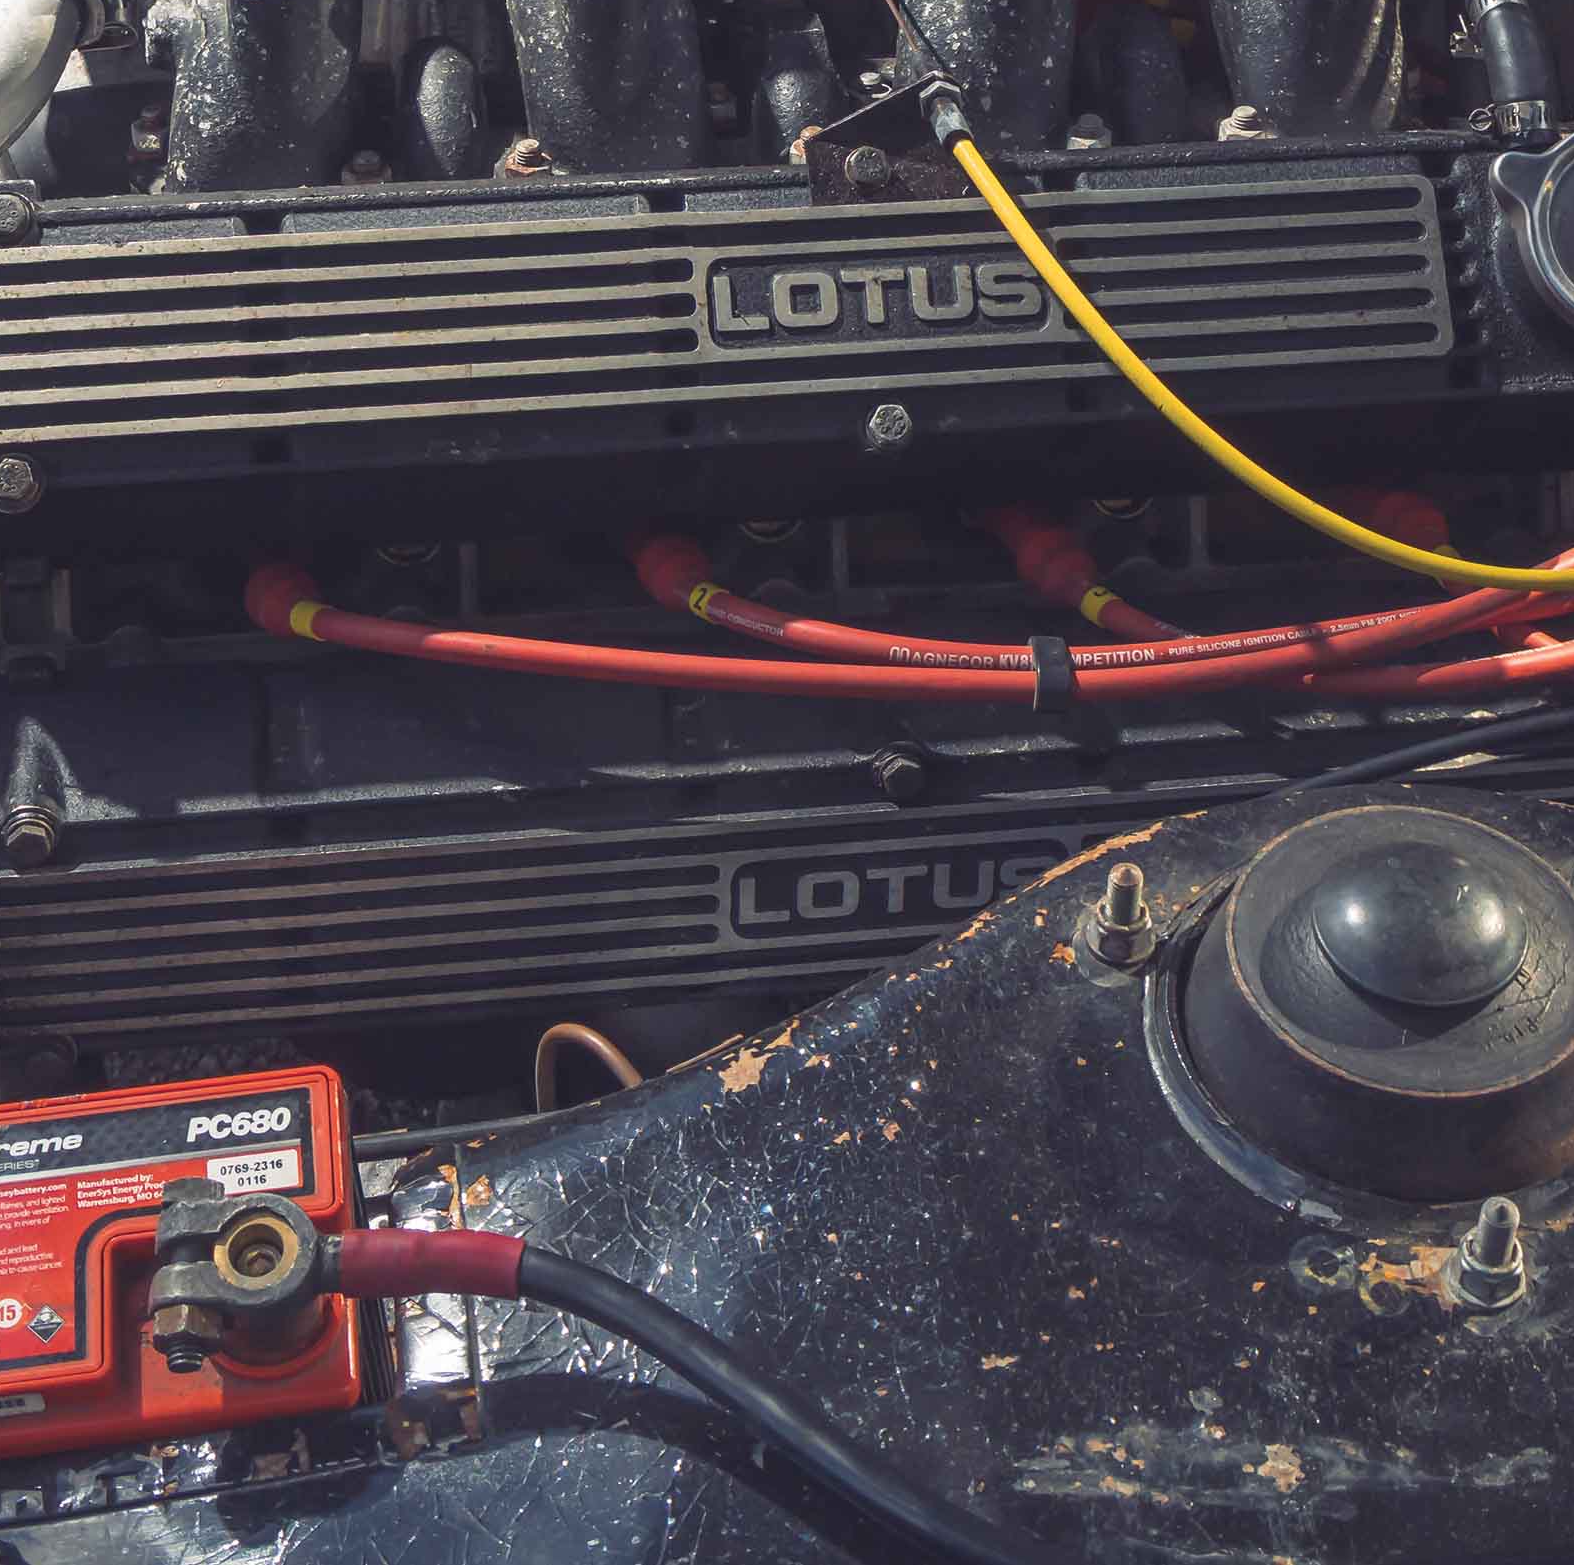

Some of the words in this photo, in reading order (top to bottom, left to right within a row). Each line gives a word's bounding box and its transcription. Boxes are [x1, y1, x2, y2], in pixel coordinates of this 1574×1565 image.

[713, 261, 1044, 332] LOTUS
[693, 587, 708, 611] 2
[1071, 648, 1155, 666] MPETITION
[1168, 646, 1195, 656] PURE
[1196, 641, 1242, 653] SILICONE
[1243, 634, 1286, 646] IGNITION
[186, 1106, 292, 1143] PC680
[219, 1159, 283, 1176] 0769-2316
[77, 1173, 137, 1190] Manufactured
[139, 1173, 153, 1181] by:
[238, 1175, 267, 1187] 0116
[77, 1187, 111, 1199] EnerSys
[112, 1183, 142, 1195] Energy
[78, 1193, 134, 1210] Warrensburg,
[136, 1192, 152, 1200] MO
